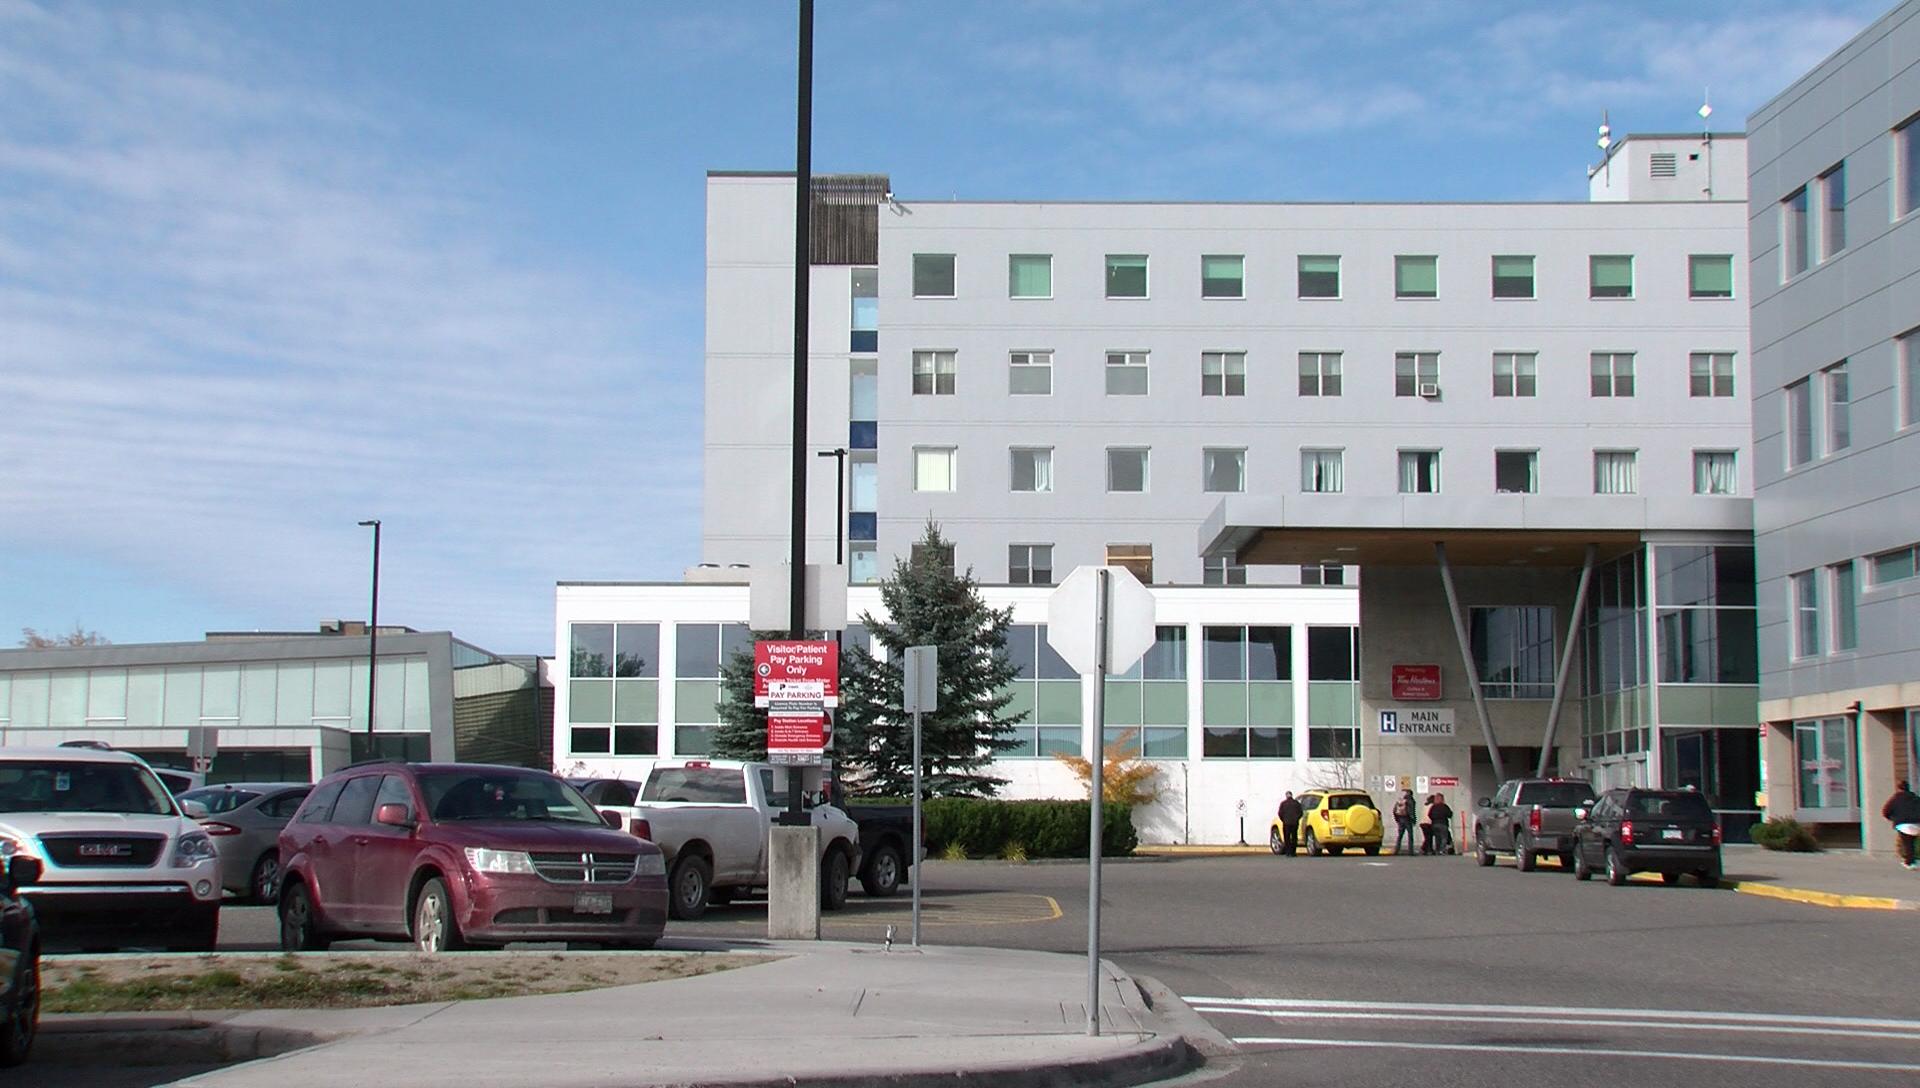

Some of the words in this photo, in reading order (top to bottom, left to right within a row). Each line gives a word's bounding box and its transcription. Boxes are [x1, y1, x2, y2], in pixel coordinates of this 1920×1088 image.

[766, 644, 828, 654] Visitor/Patient
[770, 655, 787, 666] Pay
[789, 655, 823, 666] Parking
[786, 665, 807, 676] Only
[1396, 675, 1409, 684] Tim
[1411, 712, 1439, 721] MAIN
[1399, 723, 1452, 733] ENTRANCE
[80, 844, 132, 856] GMC
